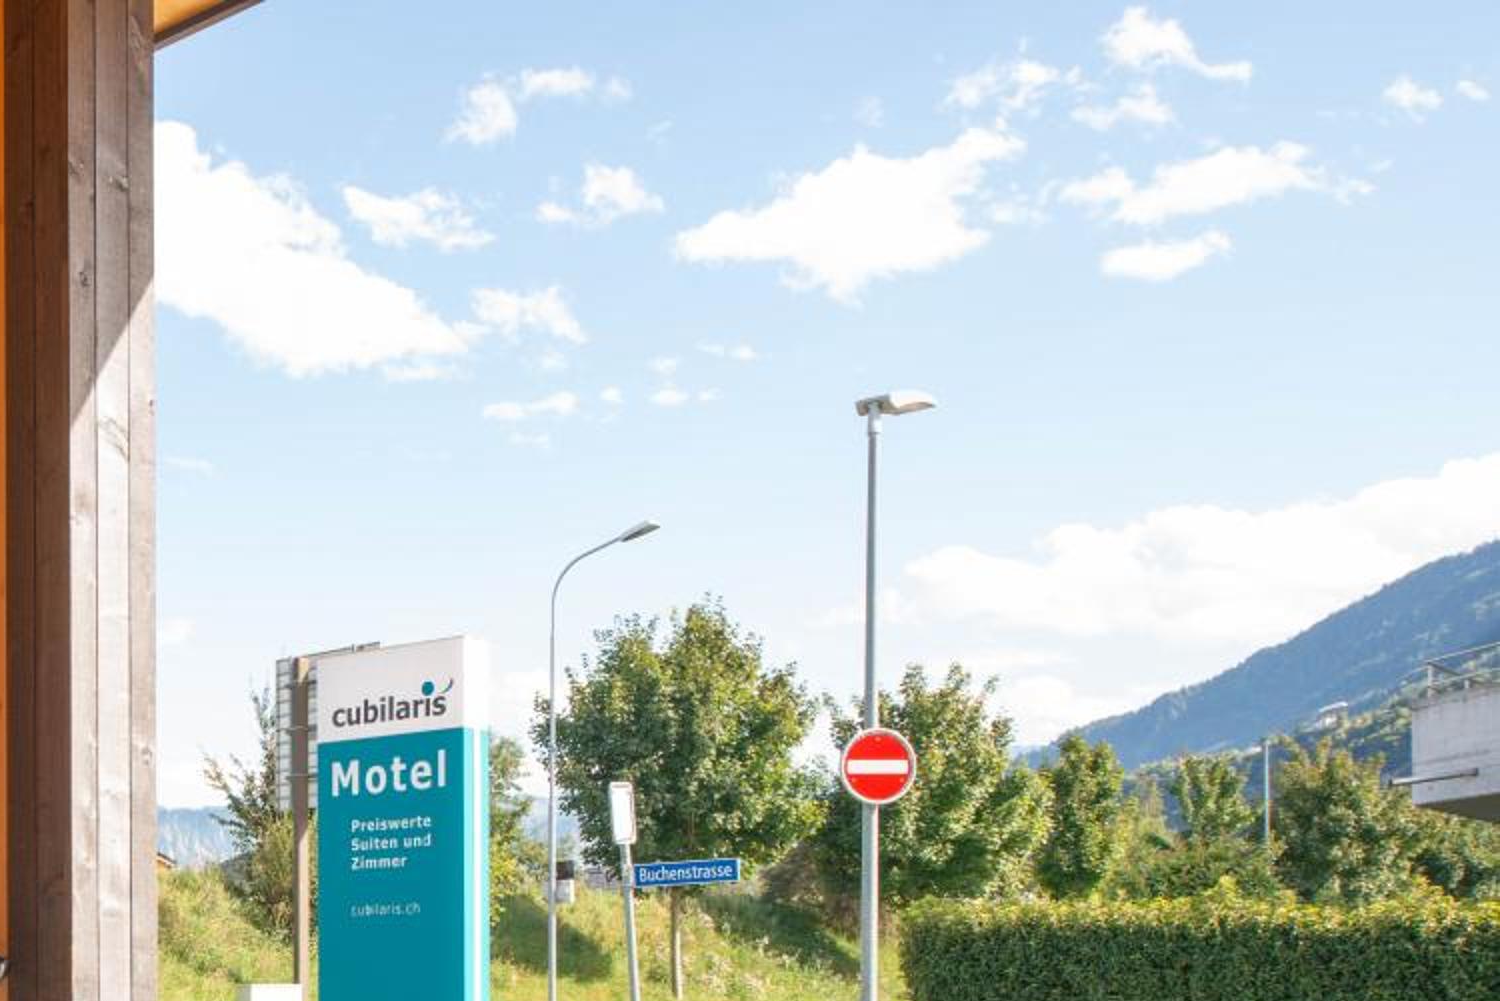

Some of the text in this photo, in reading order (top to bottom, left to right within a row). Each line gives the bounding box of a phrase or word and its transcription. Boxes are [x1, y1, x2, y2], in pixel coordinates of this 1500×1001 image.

[332, 681, 447, 727] cubilaris
[331, 749, 447, 797] Motel
[351, 815, 432, 833] Preiswerte
[351, 833, 432, 852] Suiten und
[351, 856, 408, 871] Zimmer
[639, 865, 733, 883] Buchenstrasse
[351, 901, 421, 917] cubilaris.ch
